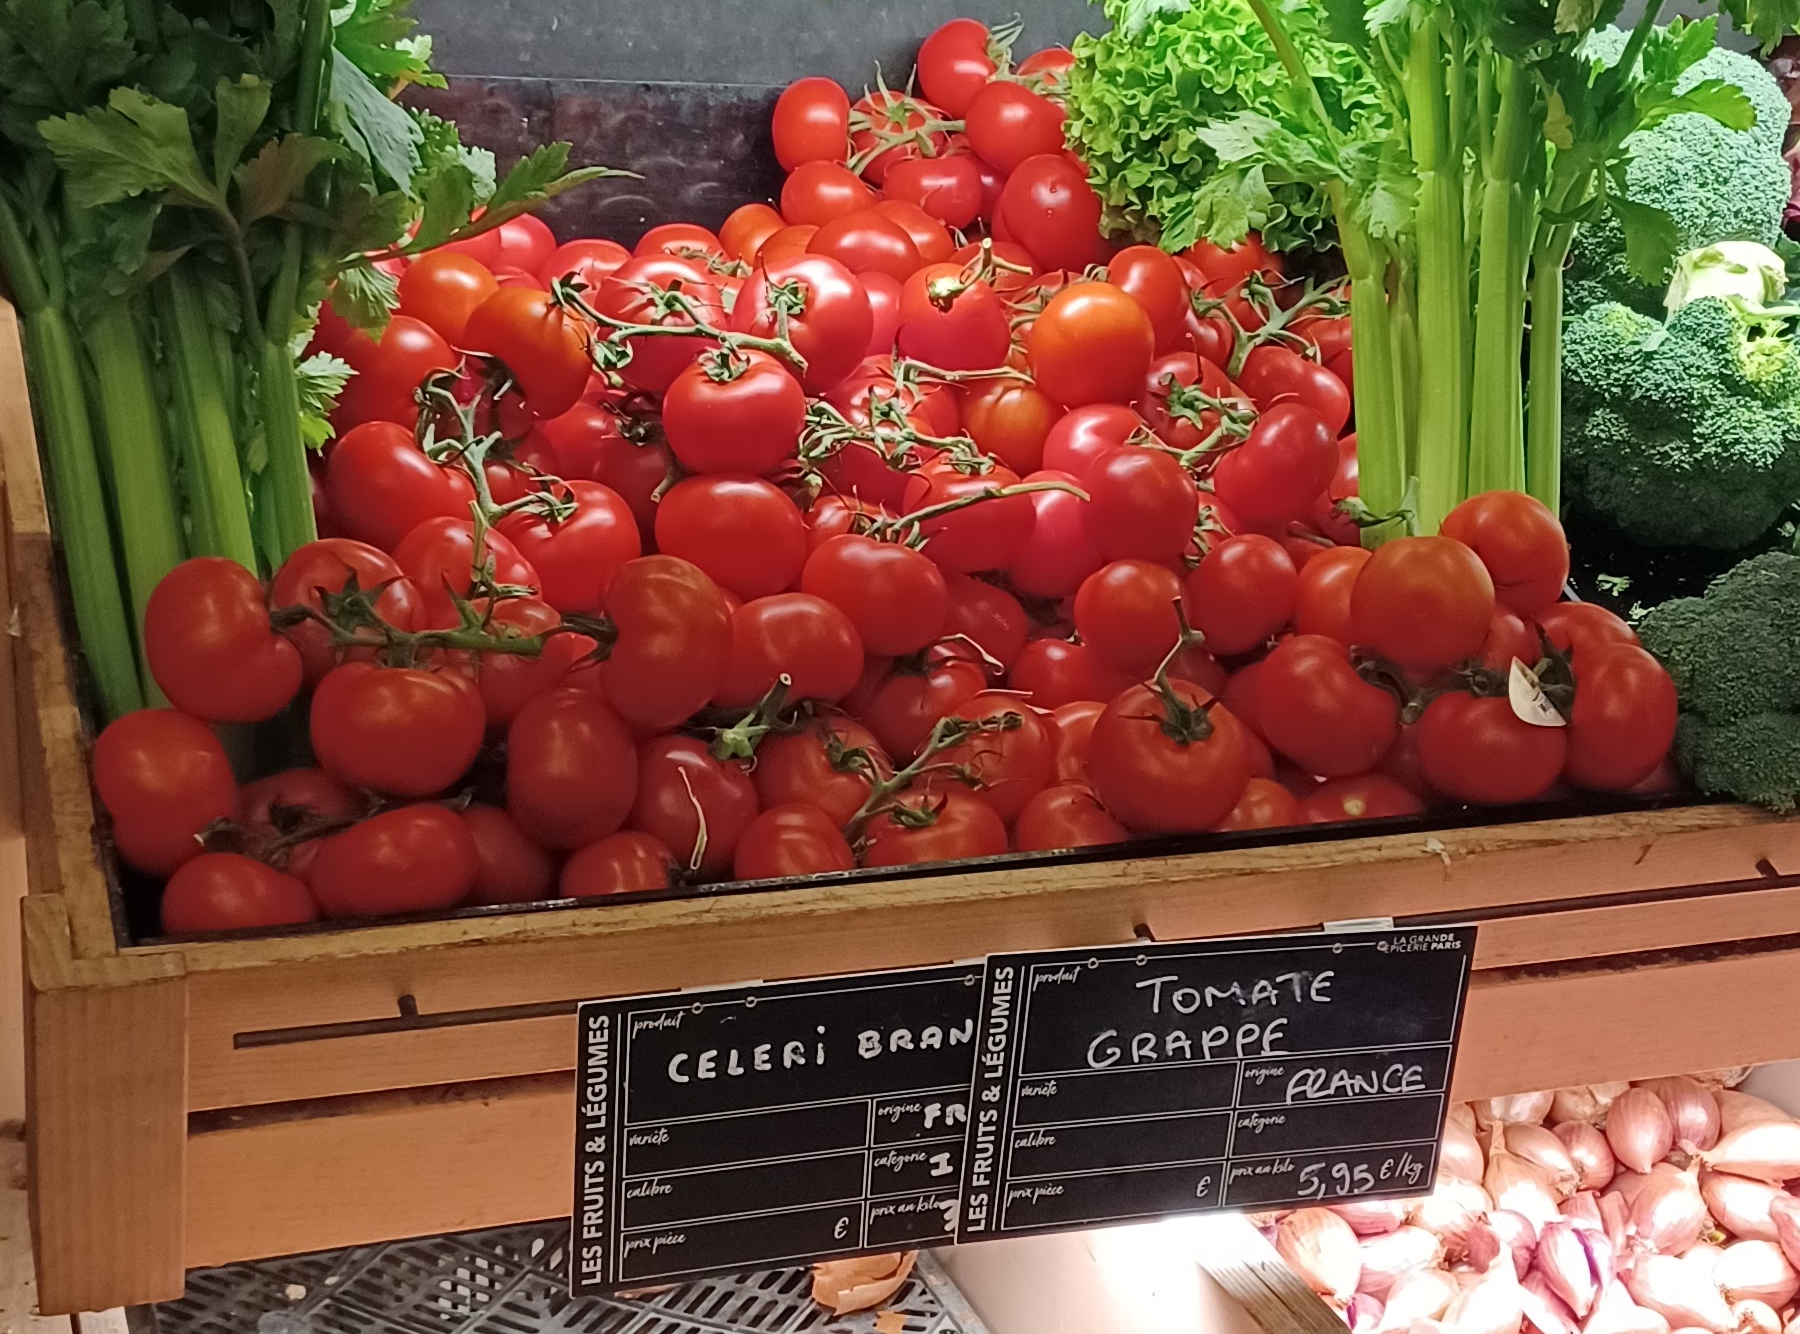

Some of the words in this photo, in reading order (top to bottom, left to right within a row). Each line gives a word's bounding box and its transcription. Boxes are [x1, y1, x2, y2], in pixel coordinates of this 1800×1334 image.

[1393, 936, 1407, 945] LA
[1409, 933, 1455, 944] GRANDE
[1430, 940, 1462, 951] PARIS
[1033, 965, 1081, 992] produit
[1135, 970, 1335, 1014] TOMATE
[632, 1010, 687, 1040] produit
[981, 965, 1015, 1079] LÉGUMES
[1087, 1017, 1289, 1069] GRAPPE
[581, 1014, 610, 1130] LÉGUMES
[1244, 1065, 1285, 1086] origine
[1285, 1063, 1427, 1105] FRANCE
[981, 1084, 1002, 1103] &
[877, 1101, 923, 1123] origine
[585, 1135, 606, 1153] &
[972, 1109, 998, 1187] FRUITS
[1014, 1127, 1057, 1149] calibre
[1229, 1167, 1254, 1185] prix
[1272, 1157, 1296, 1175] kilo
[1297, 1162, 1375, 1201] 5,95
[626, 1177, 674, 1200] calibre
[1007, 1188, 1033, 1207] prix
[1196, 1175, 1211, 1198] €
[582, 1159, 605, 1241] FRUITS
[869, 1205, 897, 1226] prix
[967, 1193, 989, 1233] LES
[833, 1216, 850, 1240] €
[624, 1236, 652, 1259] prix
[581, 1246, 603, 1287] LES
